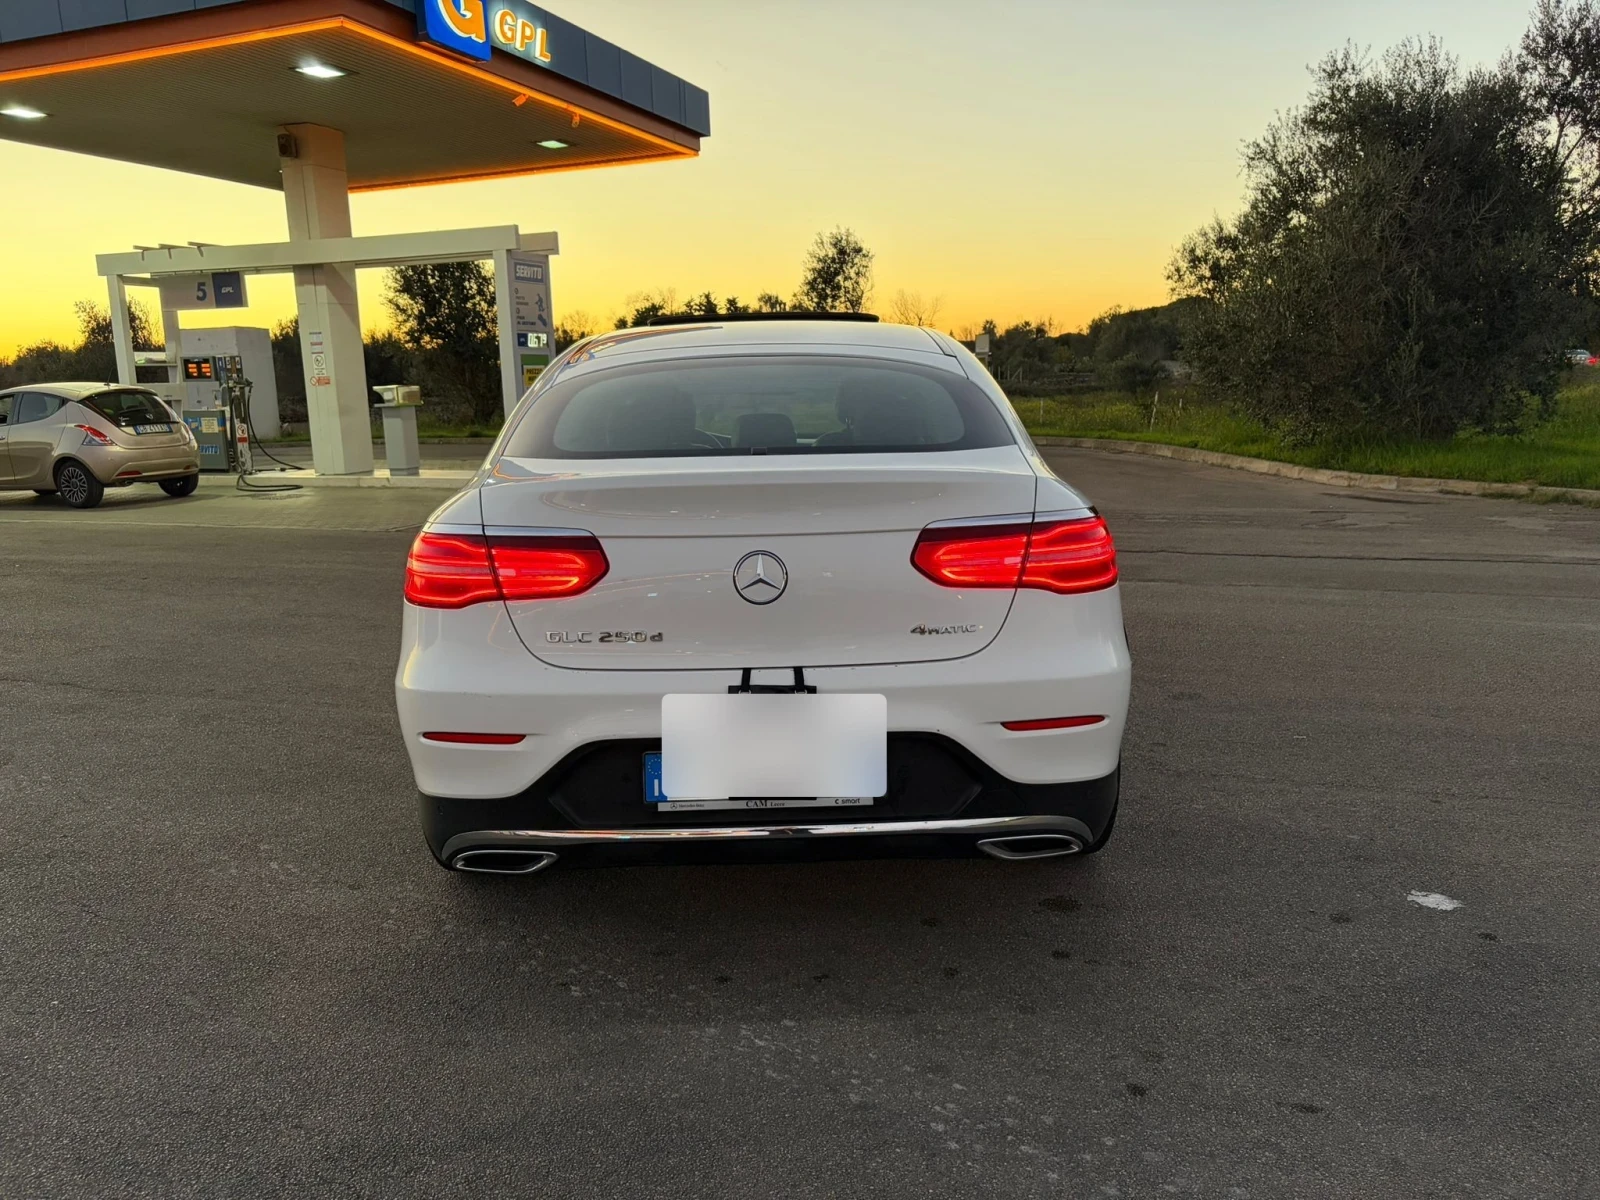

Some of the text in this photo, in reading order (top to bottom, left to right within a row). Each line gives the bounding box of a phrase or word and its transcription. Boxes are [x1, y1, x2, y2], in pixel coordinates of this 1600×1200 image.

[495, 9, 551, 62] GPL
[196, 282, 207, 301] 5
[545, 631, 592, 643] GLC
[910, 624, 976, 635] 4MATIC
[653, 778, 659, 797] I
[746, 800, 768, 808] CAM
